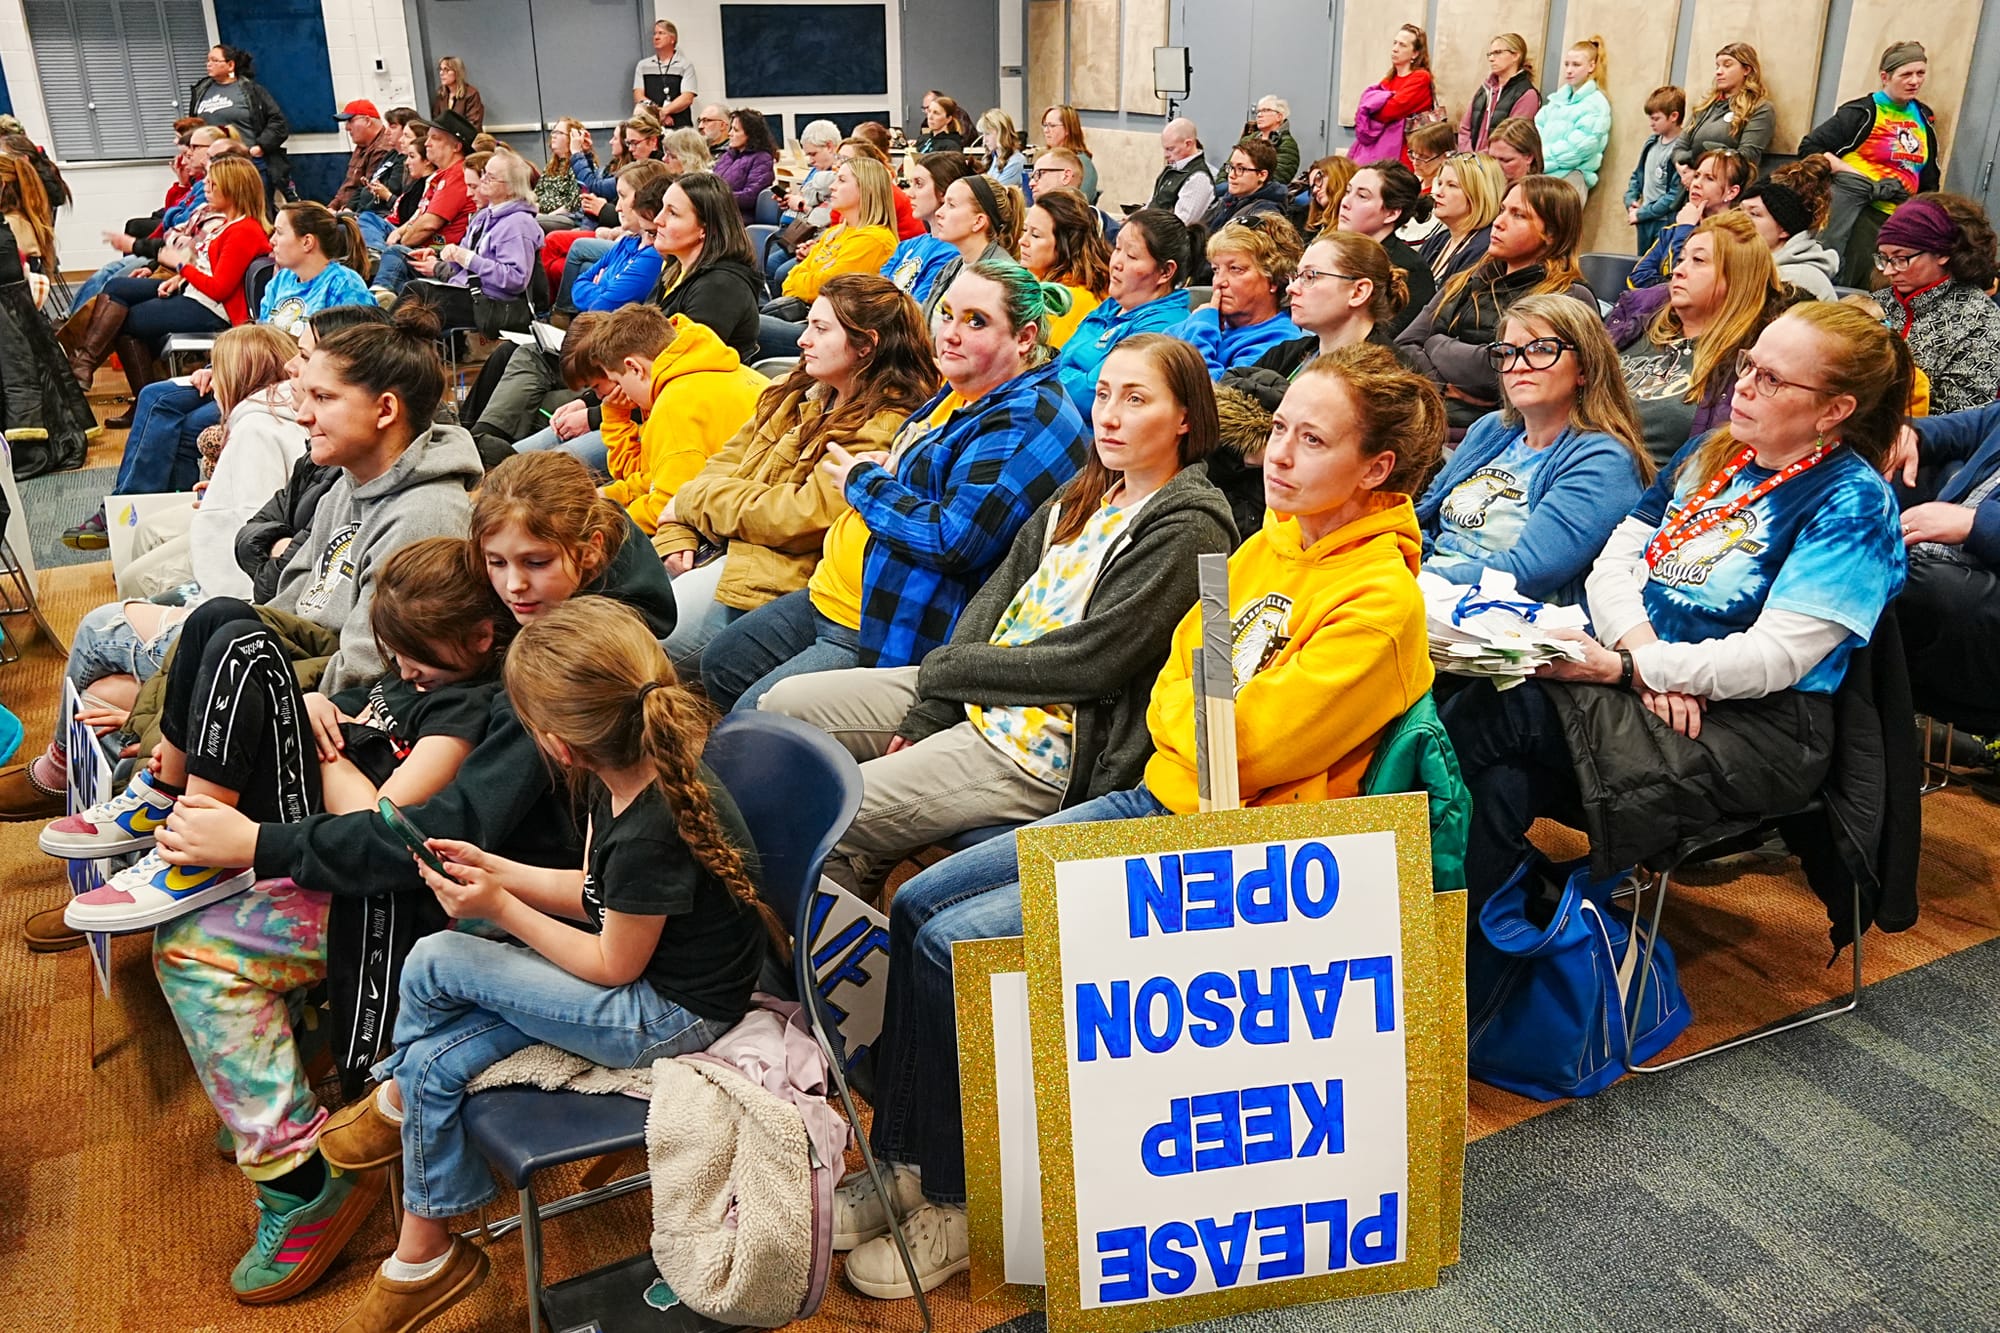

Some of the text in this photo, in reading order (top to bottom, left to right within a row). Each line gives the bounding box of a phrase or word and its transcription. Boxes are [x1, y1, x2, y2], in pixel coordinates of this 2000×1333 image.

[1651, 551, 1713, 588] Eagles
[1125, 841, 1340, 938] OPEN
[1074, 954, 1396, 1063] LARSON
[1141, 1079, 1346, 1179] KEEP
[1096, 1191, 1398, 1304] PLEASE
